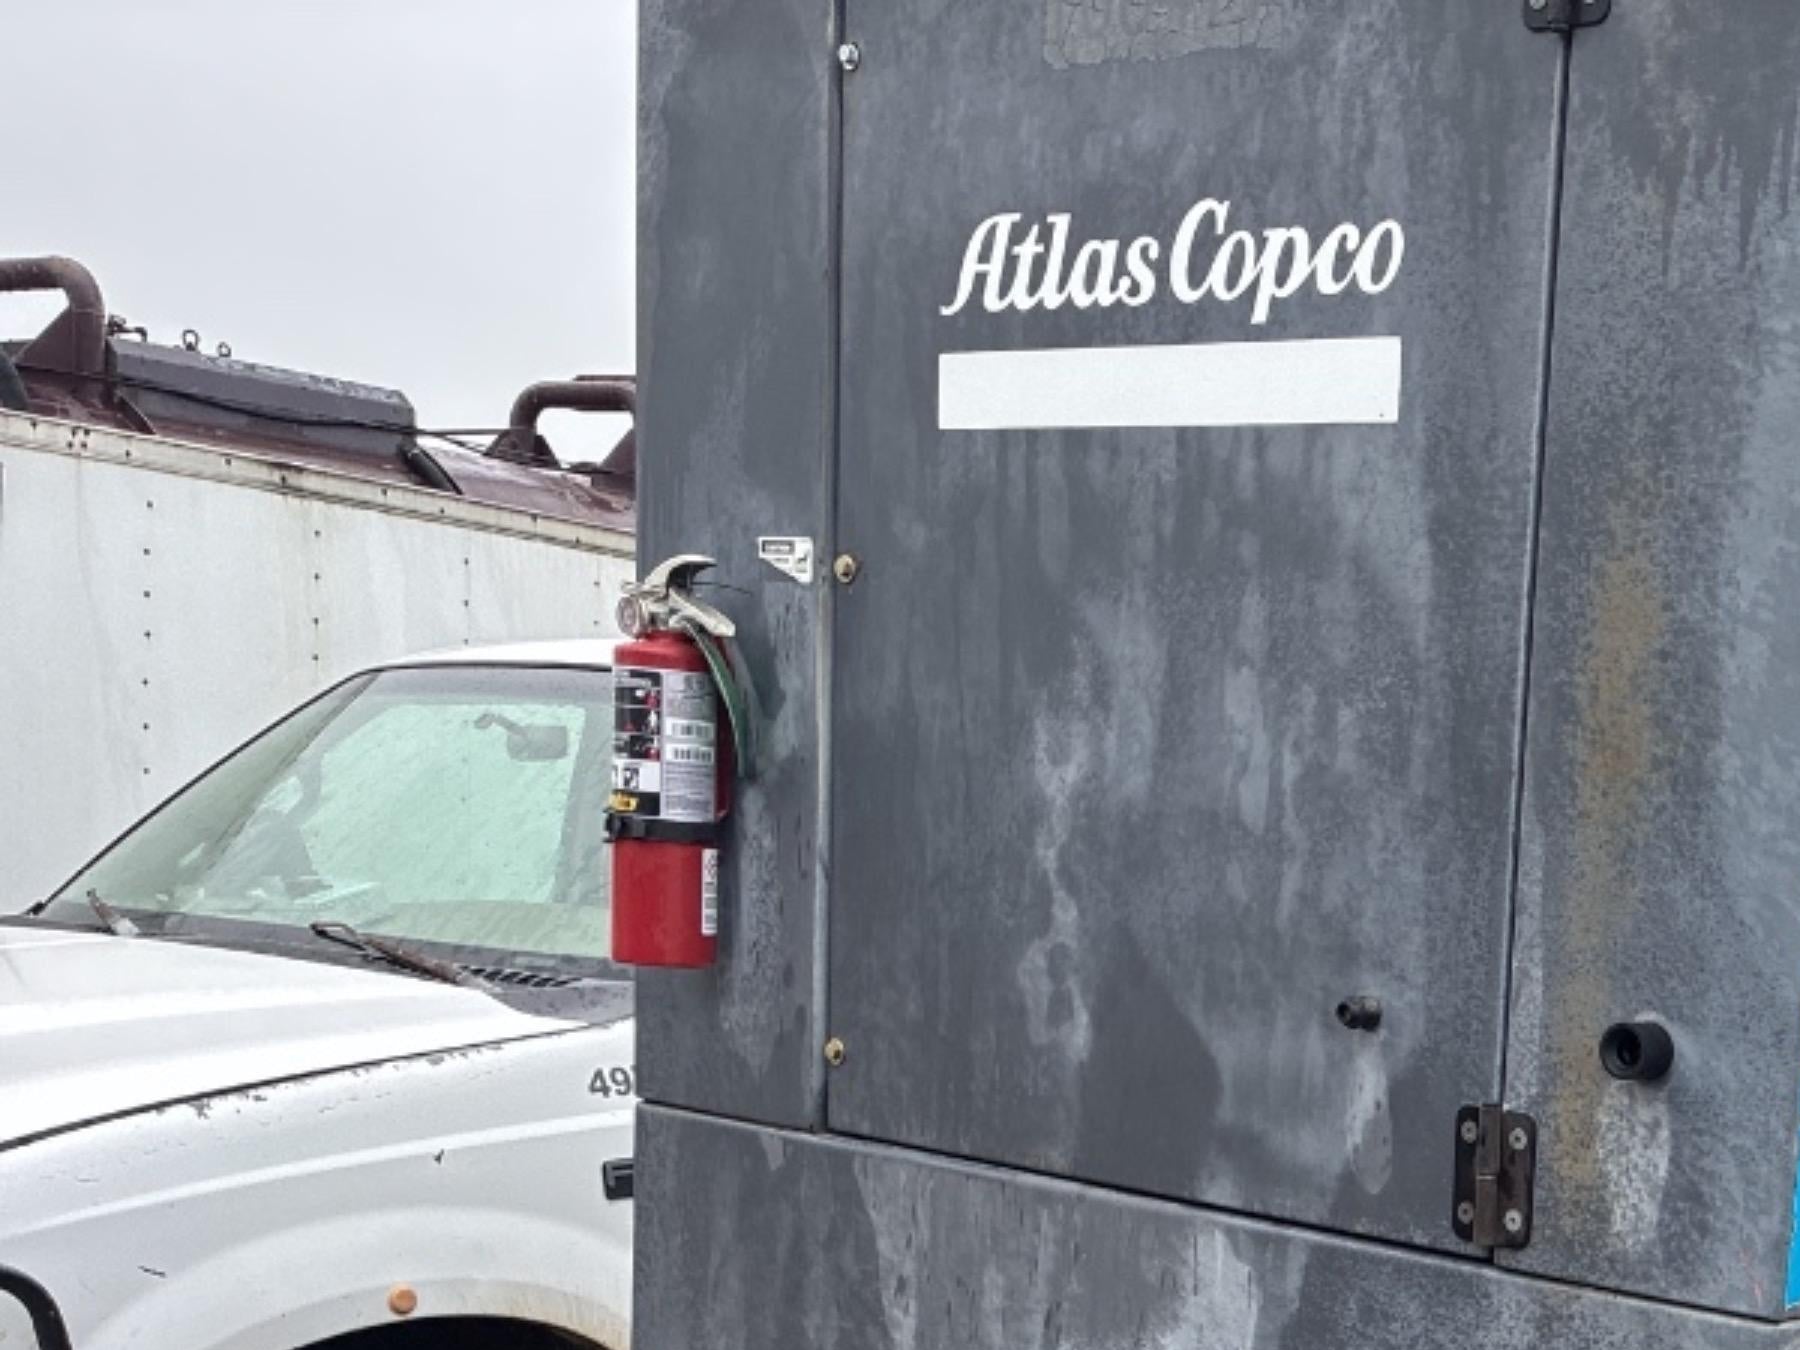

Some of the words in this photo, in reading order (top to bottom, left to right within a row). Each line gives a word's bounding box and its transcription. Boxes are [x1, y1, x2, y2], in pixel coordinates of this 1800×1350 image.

[941, 212, 1159, 316] Atlas
[1169, 197, 1405, 325] Copco
[588, 1067, 636, 1098] 49
